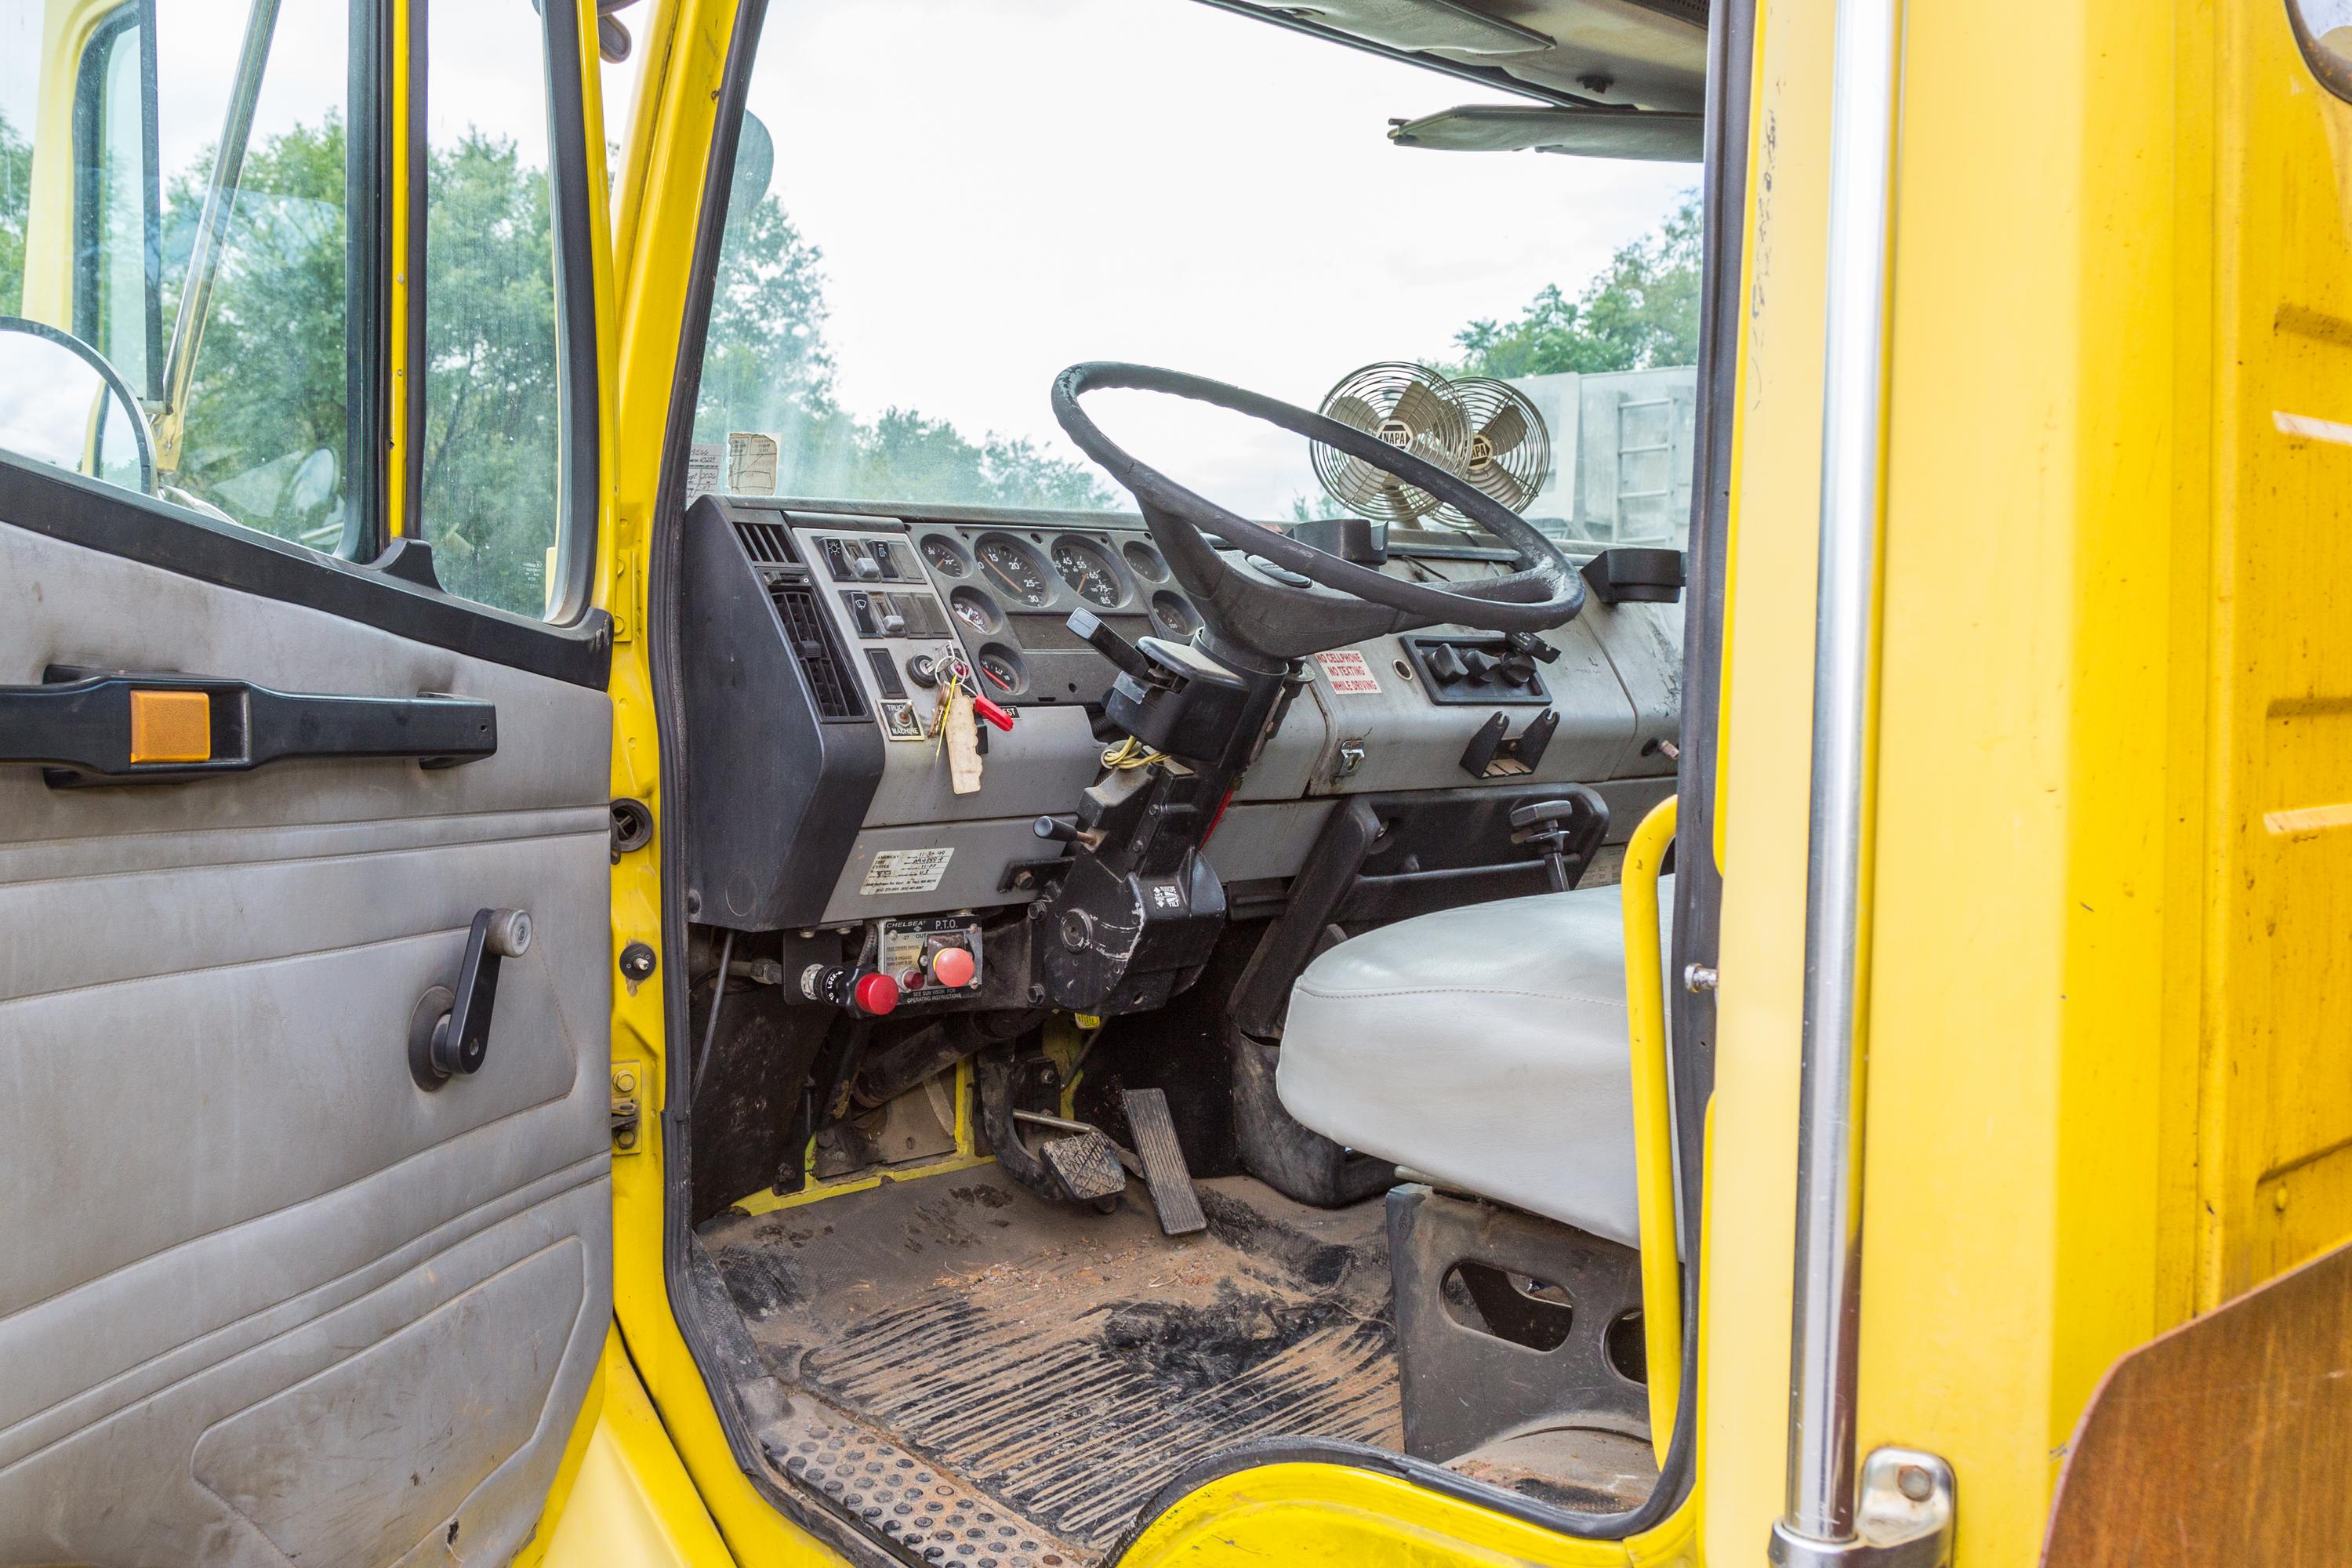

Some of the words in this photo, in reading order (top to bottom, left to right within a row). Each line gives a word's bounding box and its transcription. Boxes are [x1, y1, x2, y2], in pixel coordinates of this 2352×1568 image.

[1383, 432, 1405, 445] NAPA
[1462, 445, 1486, 459] APA
[989, 554, 999, 562] 15
[978, 561, 985, 570] 0
[1008, 561, 1020, 570] 20
[1317, 653, 1327, 663] NO
[1327, 653, 1363, 663] CELLPHONE
[1328, 666, 1338, 676] NO
[1338, 666, 1365, 676] TEXTING
[1330, 681, 1352, 691] WHILE
[1351, 680, 1377, 691] DRIVING
[935, 919, 958, 930] P.T.O.
[828, 973, 837, 989] LOCK
[829, 993, 835, 1001] TO
[931, 993, 962, 1001] INSTRUCTIONS
